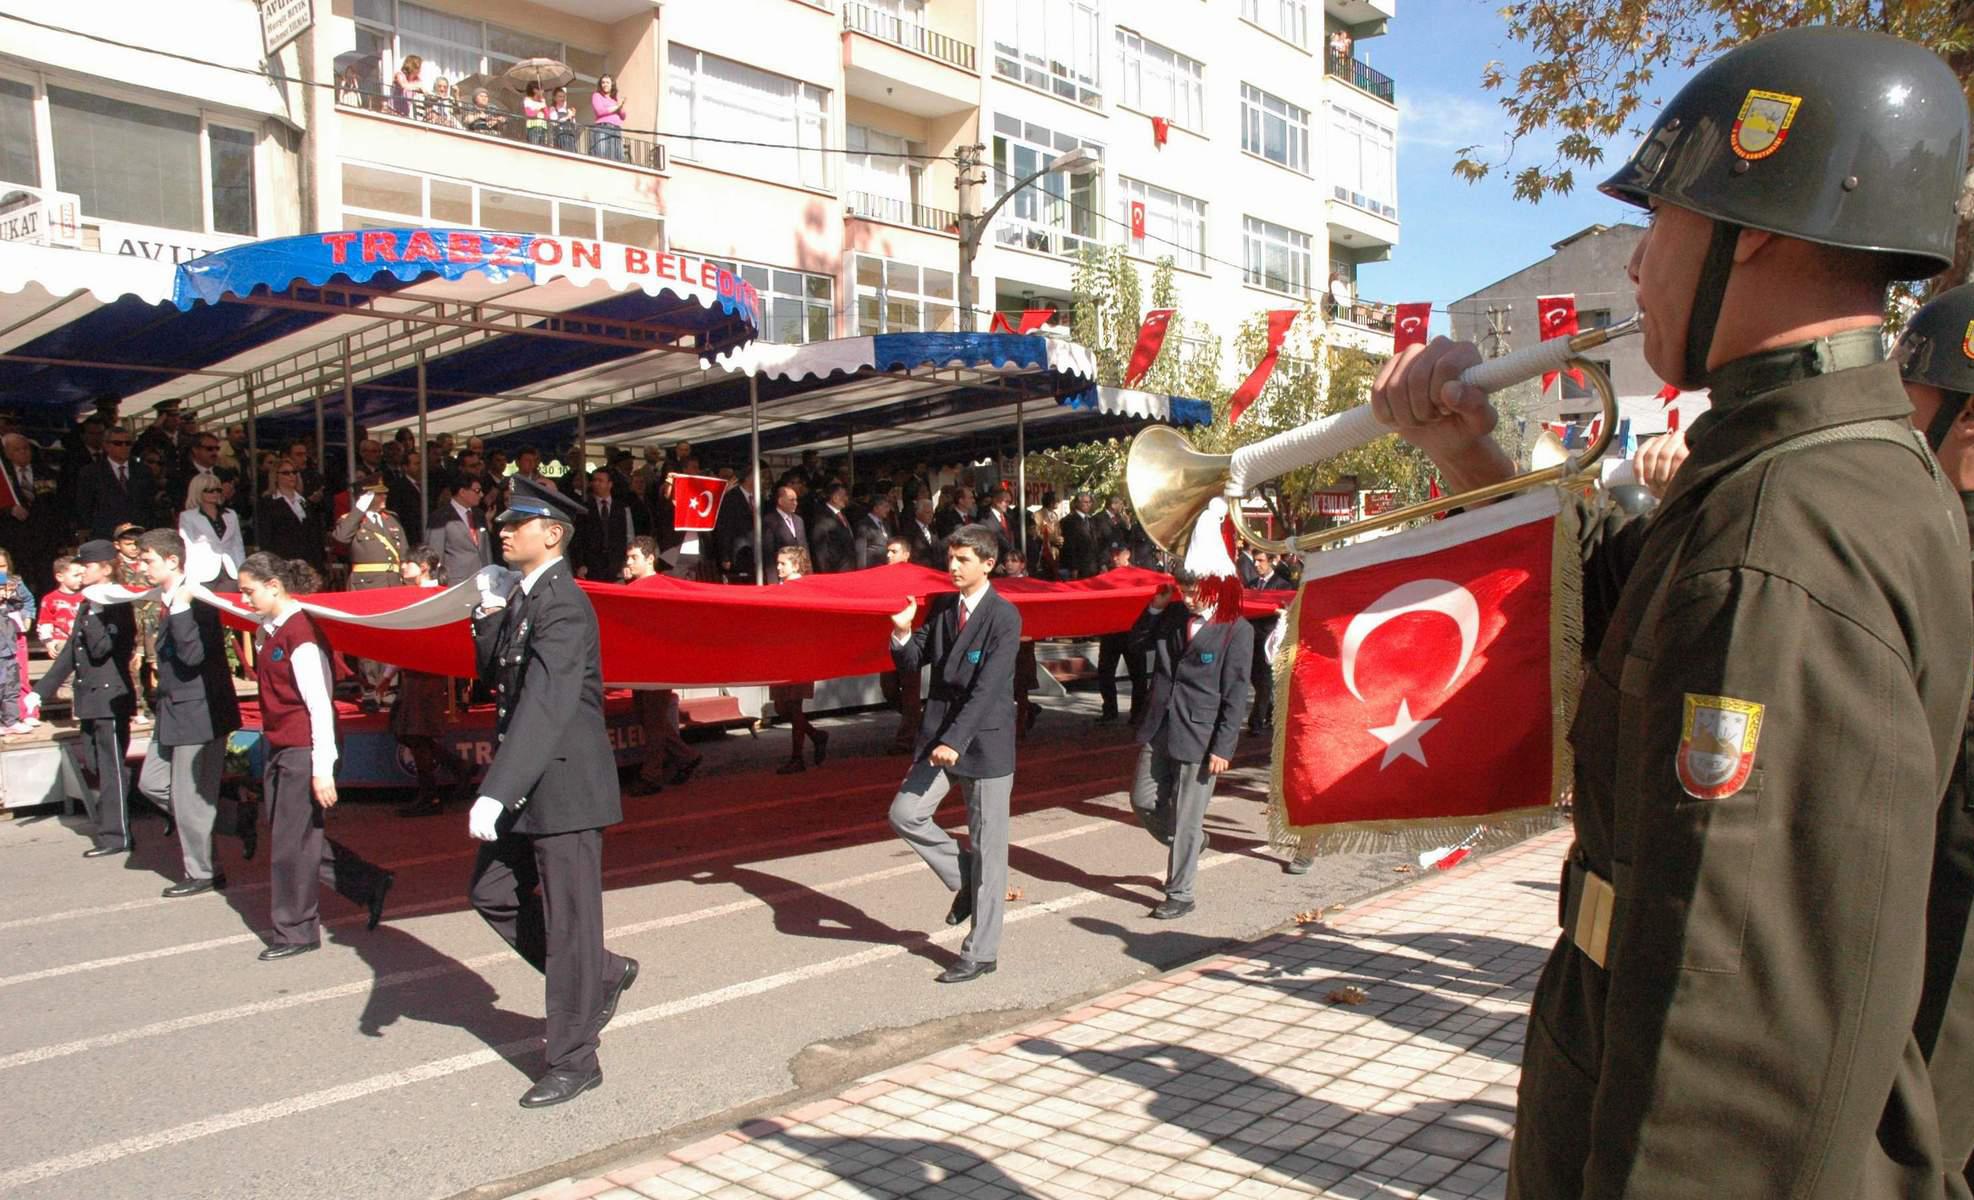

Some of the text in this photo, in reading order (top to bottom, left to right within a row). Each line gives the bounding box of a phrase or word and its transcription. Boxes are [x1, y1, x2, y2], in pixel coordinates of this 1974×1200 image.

[118, 238, 213, 265] AVU
[322, 230, 601, 270] TRABZON
[456, 741, 494, 765] TR
